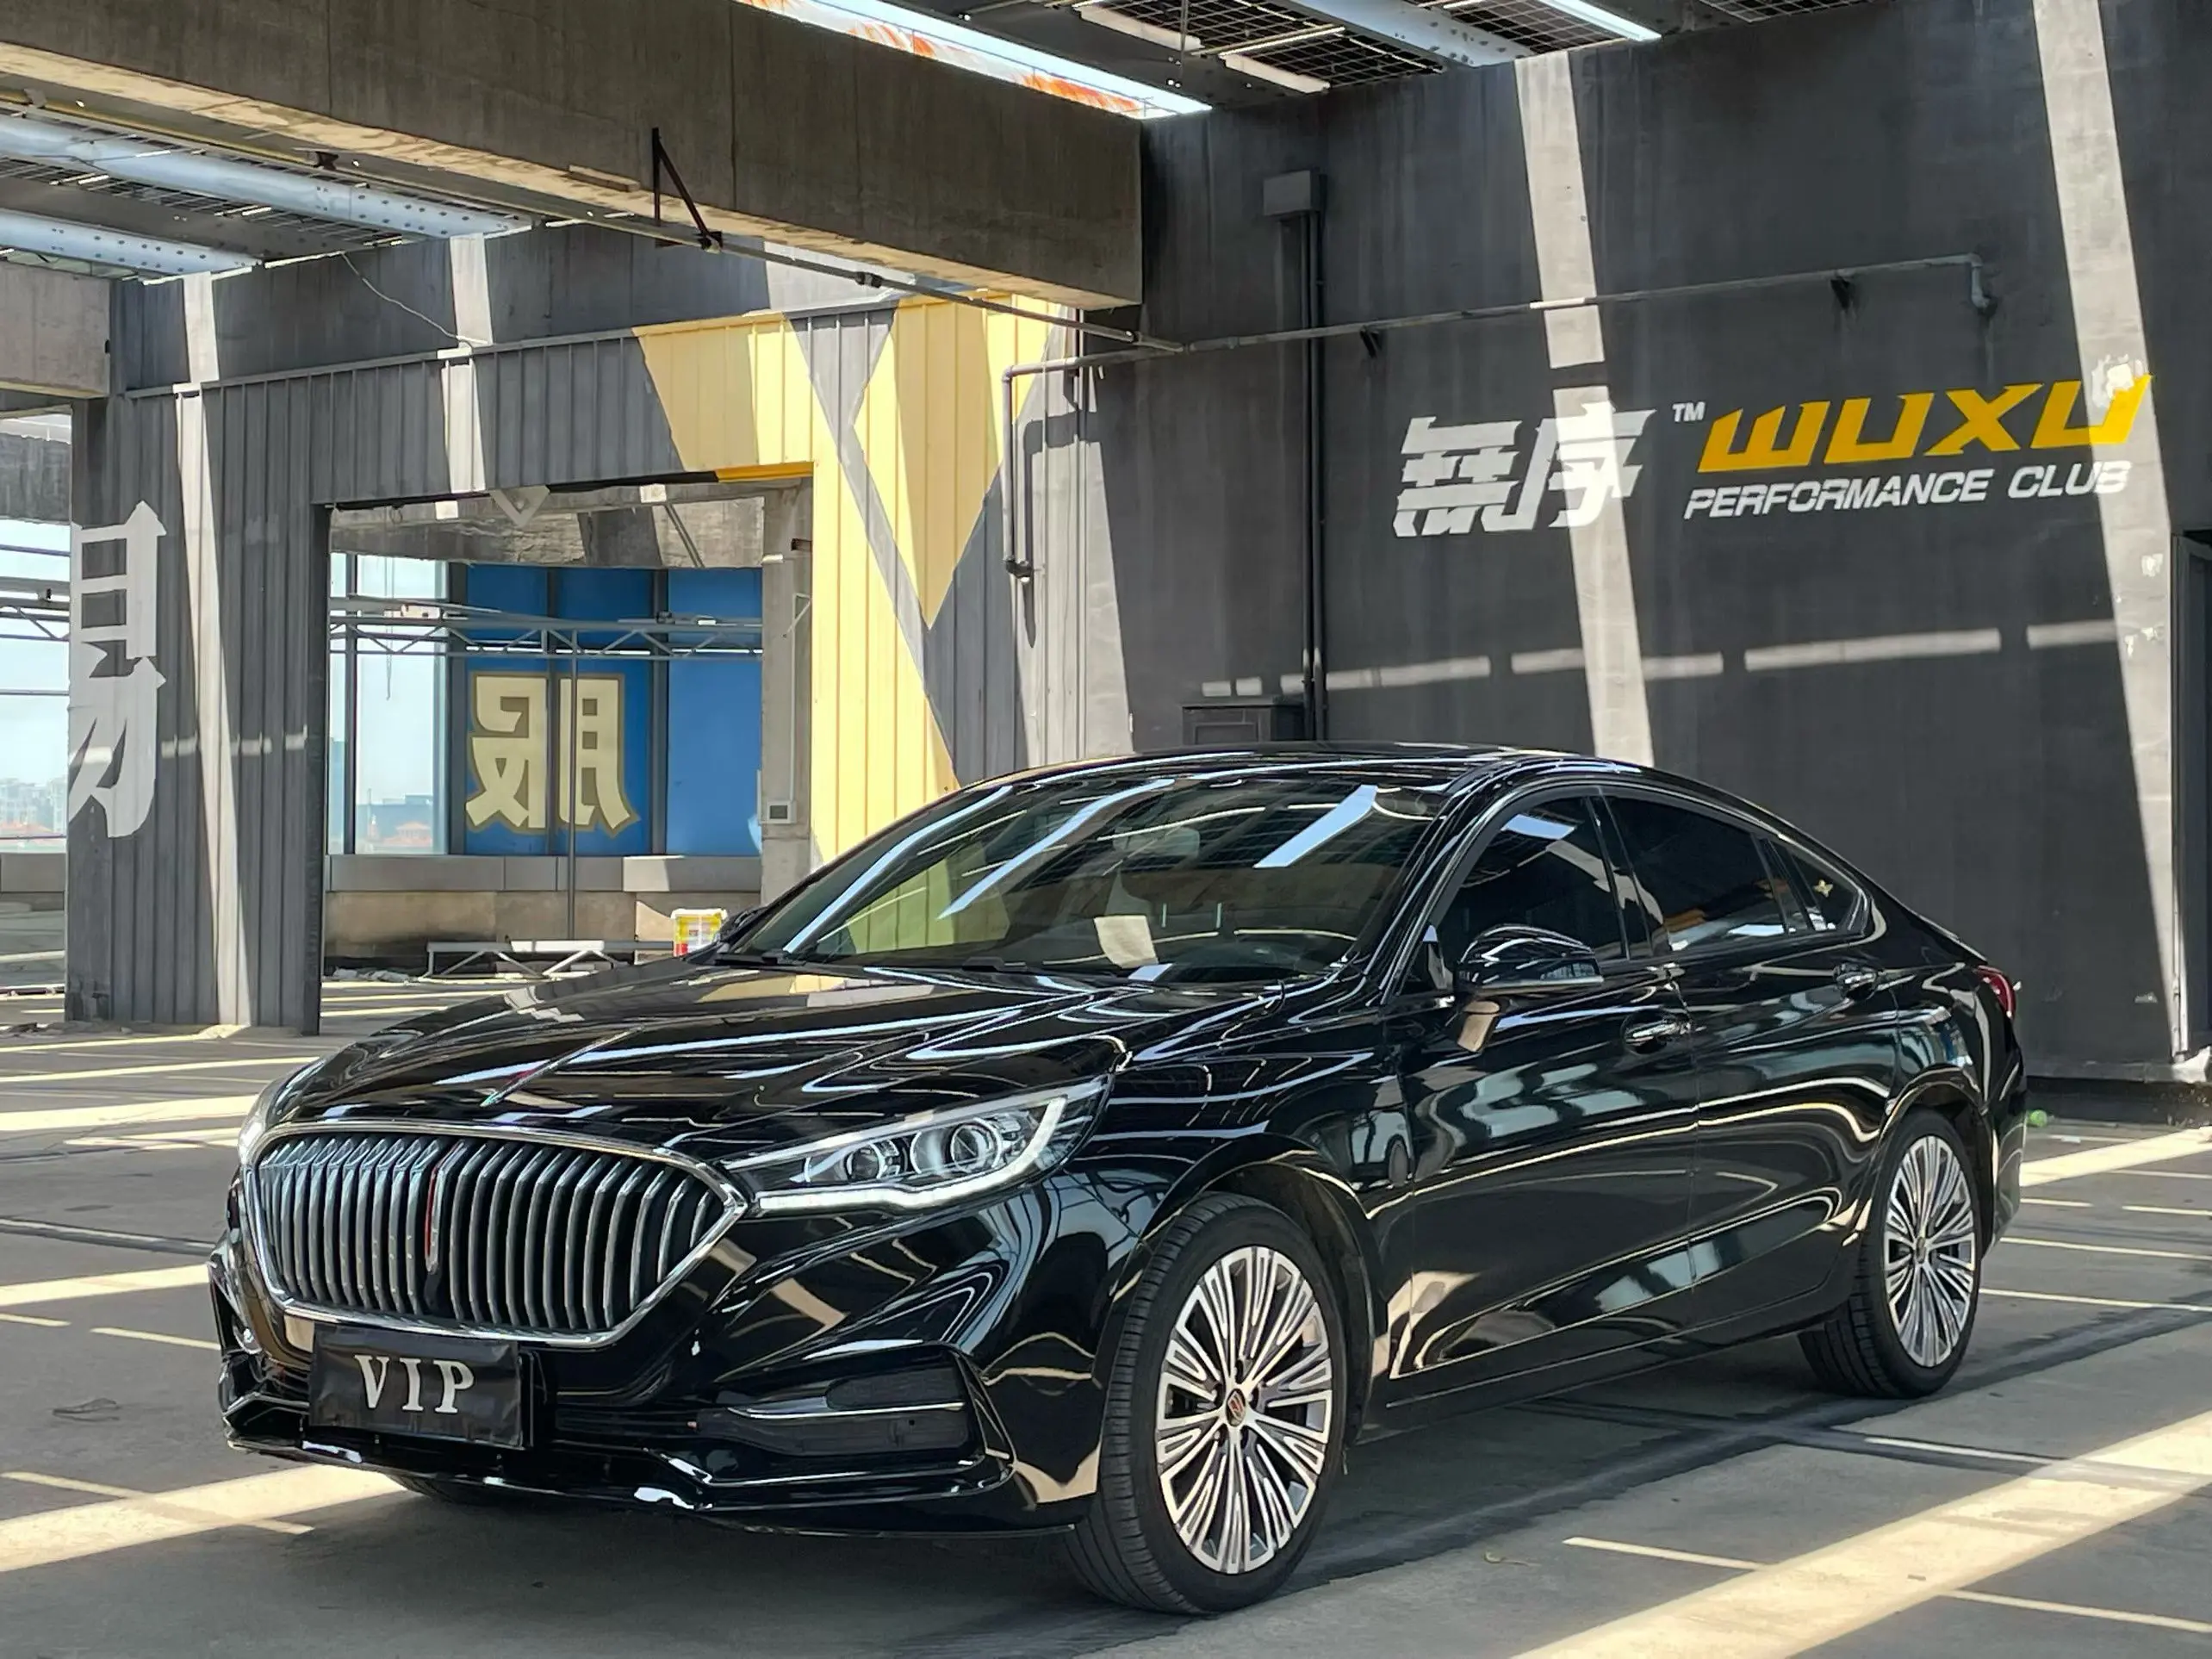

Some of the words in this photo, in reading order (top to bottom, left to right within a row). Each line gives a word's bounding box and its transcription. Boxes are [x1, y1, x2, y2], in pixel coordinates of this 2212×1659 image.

[1698, 374, 2152, 473] WUXU
[1683, 468, 1996, 519] PERFORMANCE
[2008, 460, 2133, 499] CLUB
[353, 1353, 475, 1414] VIP
